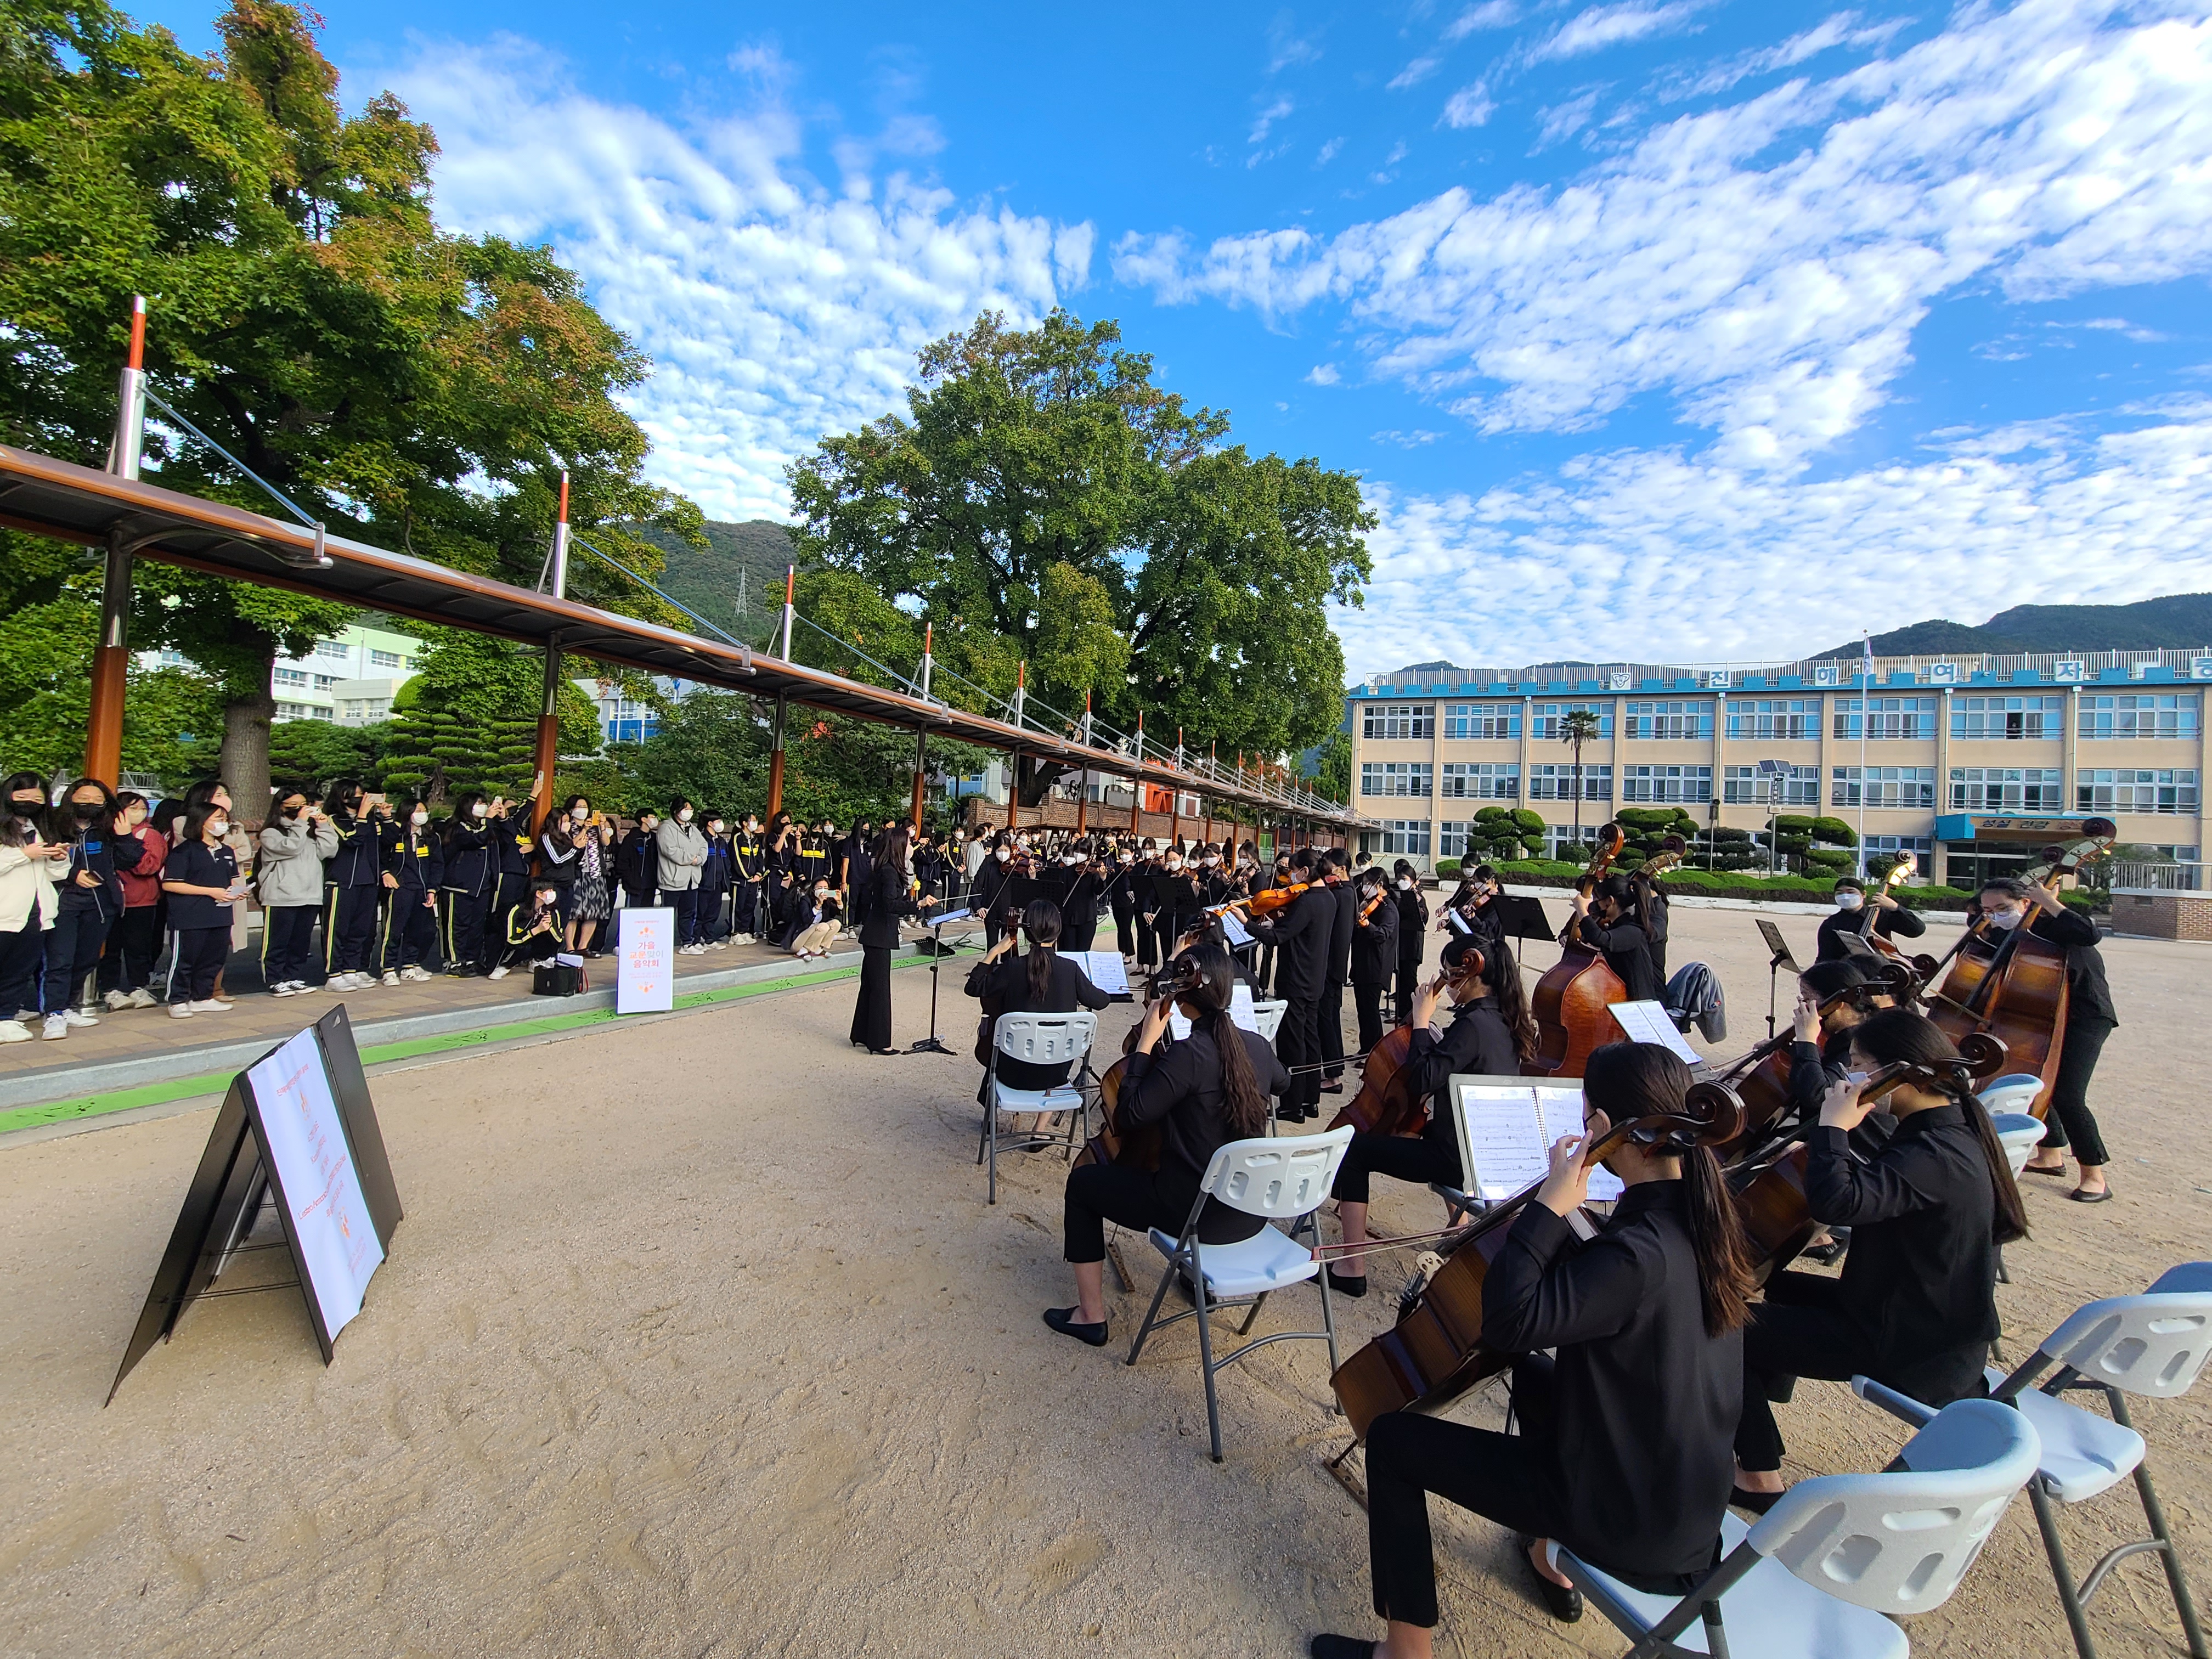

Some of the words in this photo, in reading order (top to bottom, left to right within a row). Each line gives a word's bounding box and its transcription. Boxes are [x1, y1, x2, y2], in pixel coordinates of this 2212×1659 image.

[1982, 819, 2012, 828] 성실
[2019, 820, 2050, 829] 건강
[637, 941, 656, 950] 가을
[633, 959, 659, 968] 음악회
